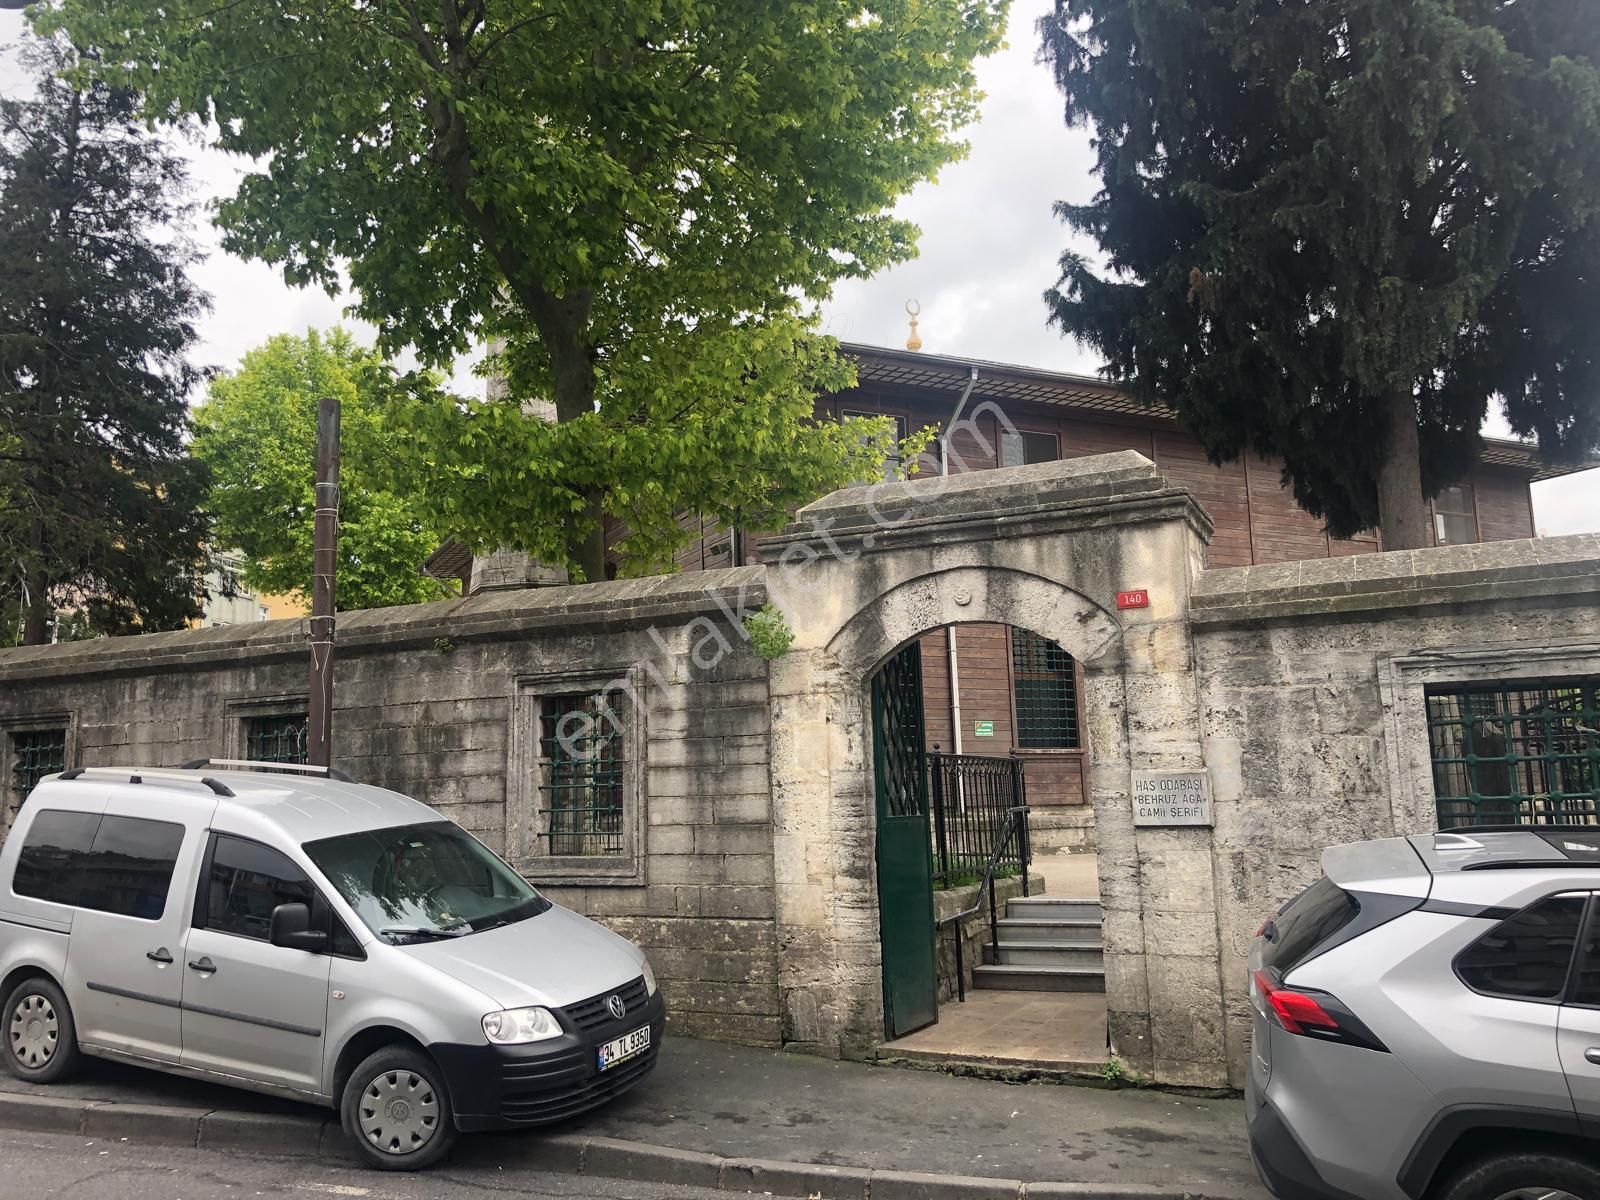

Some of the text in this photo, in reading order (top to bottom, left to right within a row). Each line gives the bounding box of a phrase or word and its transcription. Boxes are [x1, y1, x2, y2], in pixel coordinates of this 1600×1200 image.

[1124, 593, 1142, 604] 140
[1136, 780, 1202, 792] HAS ODABAŞI
[1138, 795, 1177, 804] BEHRUZ
[605, 1044, 614, 1062] 34
[619, 1038, 628, 1055] TL
[631, 1028, 648, 1050] 9350
